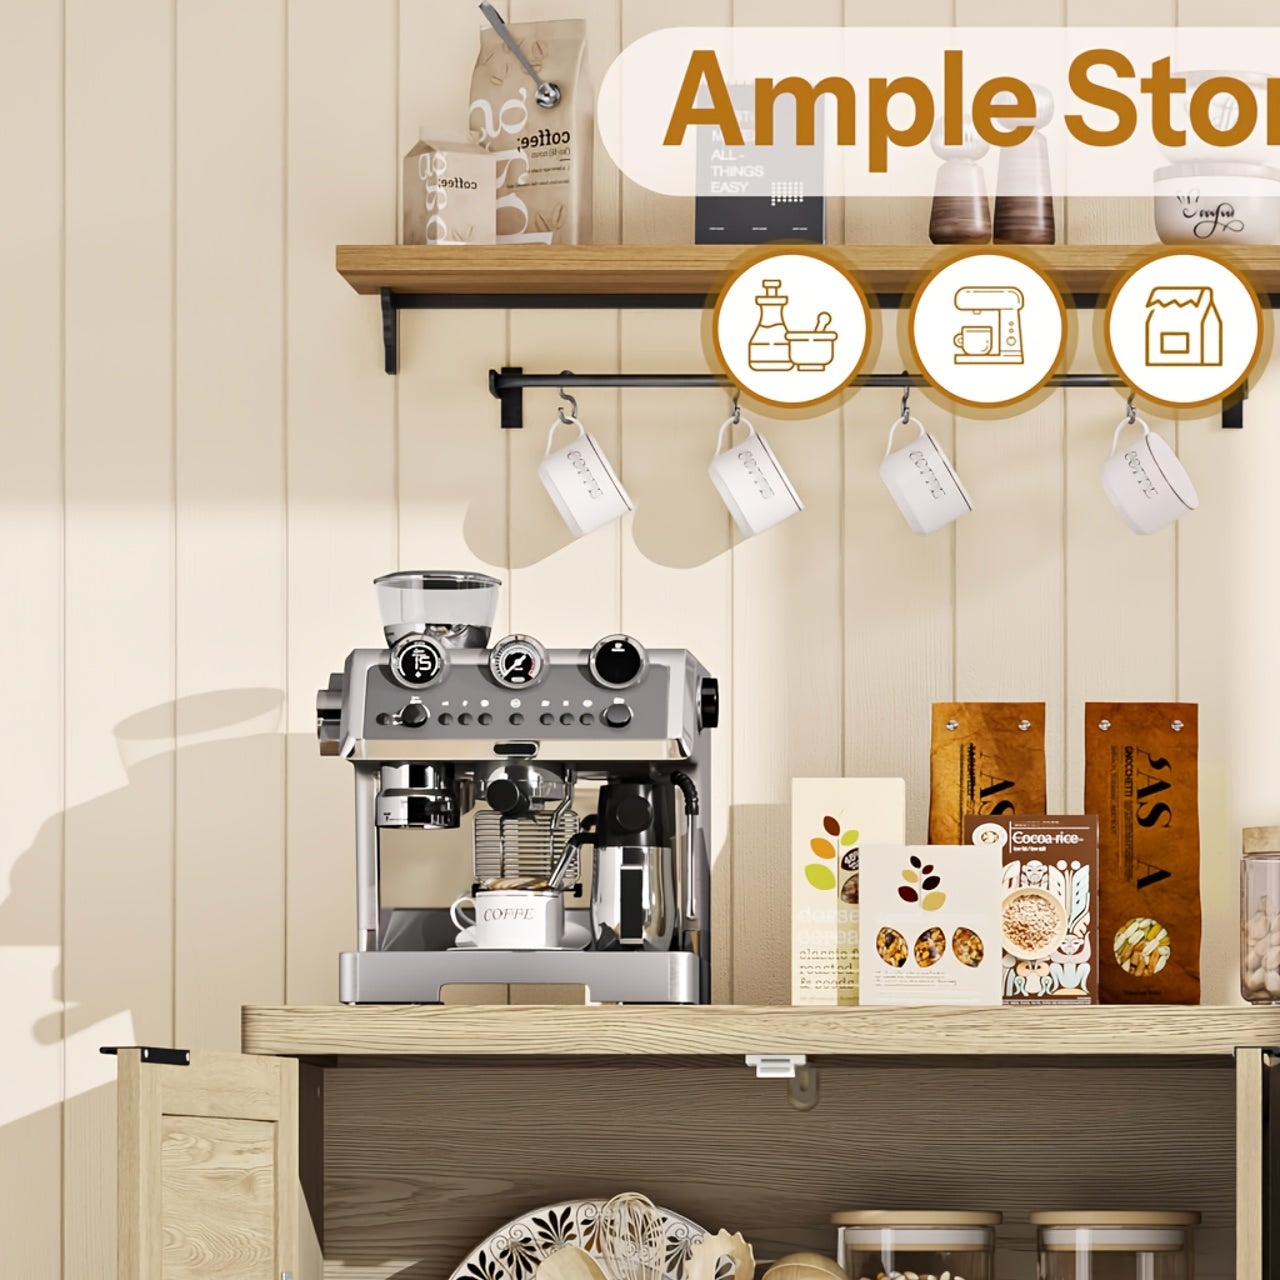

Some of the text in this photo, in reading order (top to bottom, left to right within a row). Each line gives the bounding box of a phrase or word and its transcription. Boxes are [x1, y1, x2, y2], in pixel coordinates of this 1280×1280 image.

[711, 148, 737, 161] ALL
[710, 164, 764, 177] THINGS
[710, 181, 749, 193] EASY
